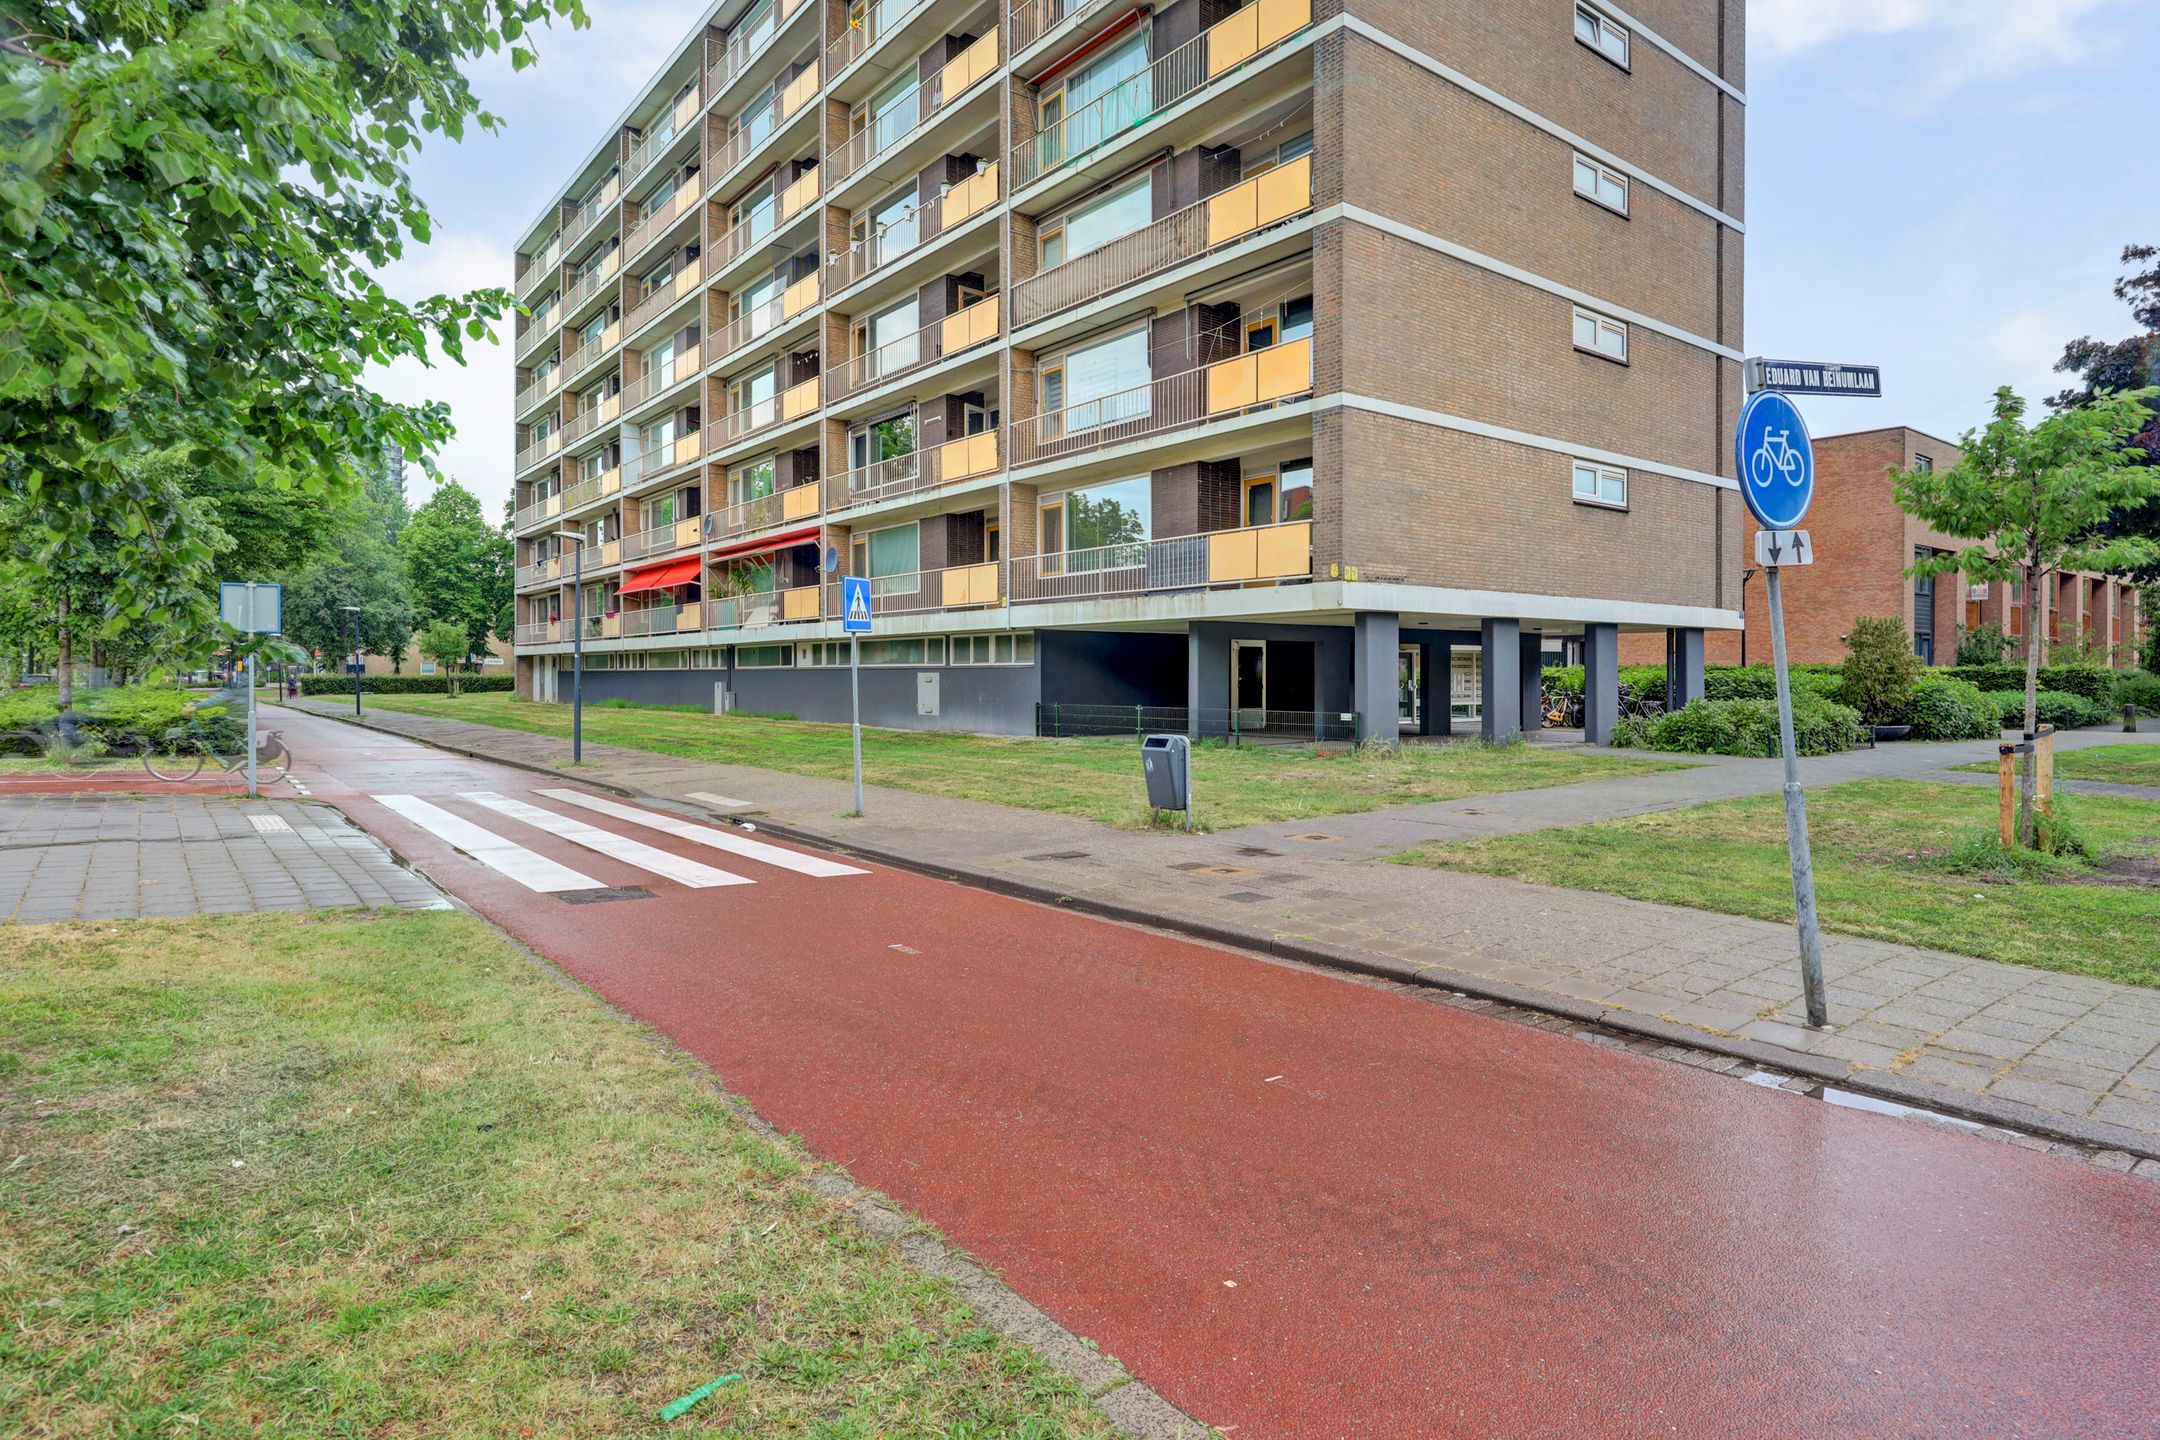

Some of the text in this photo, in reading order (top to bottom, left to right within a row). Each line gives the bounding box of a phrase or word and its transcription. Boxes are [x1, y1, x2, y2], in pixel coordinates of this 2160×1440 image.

[1766, 367, 1875, 389] EDUARD VAN BEINUMLAAN
